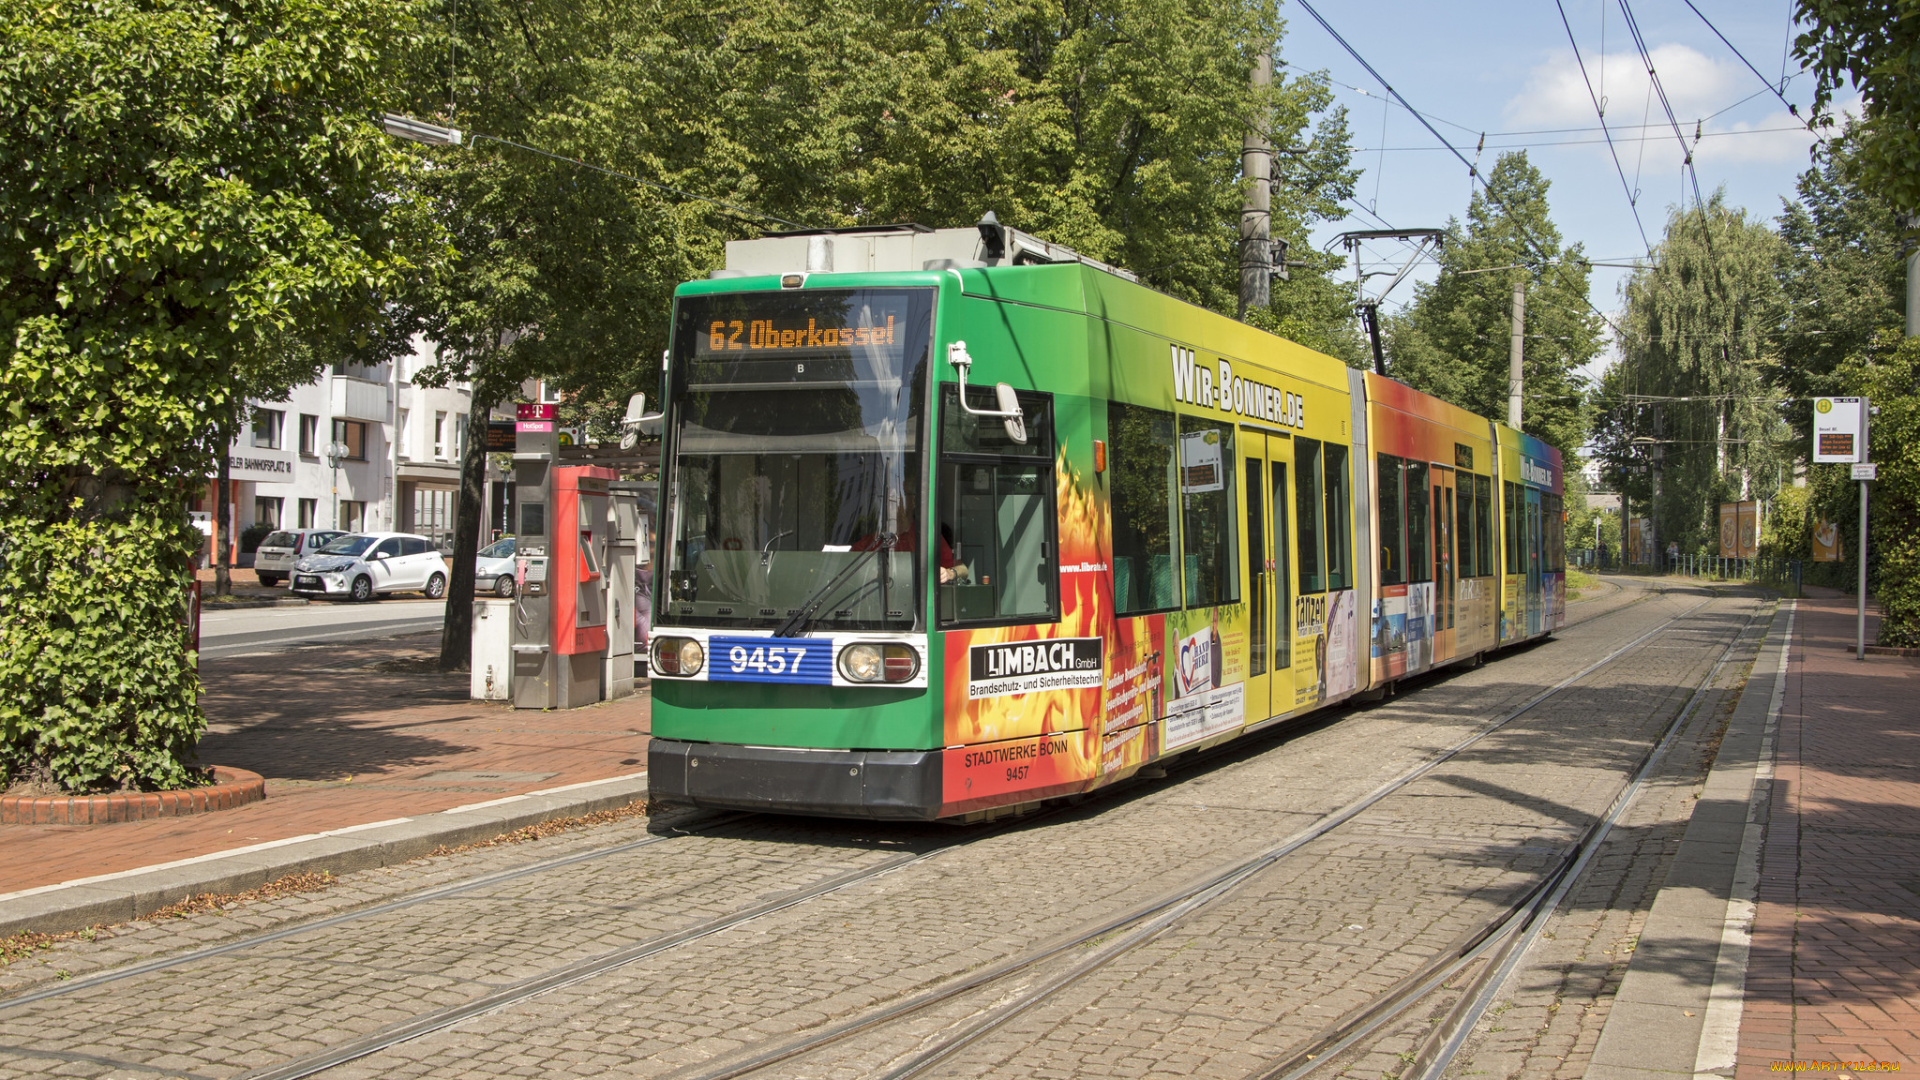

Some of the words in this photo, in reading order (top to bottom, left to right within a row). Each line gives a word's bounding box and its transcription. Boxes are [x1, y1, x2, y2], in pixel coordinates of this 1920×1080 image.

[710, 320, 743, 351] 62
[750, 316, 895, 349] Oberkassel
[797, 363, 805, 374] B
[532, 404, 543, 418] T
[228, 456, 243, 469] ELER
[244, 458, 285, 473] BAHNHOFSPLATZ
[286, 461, 291, 473] 18
[1296, 595, 1325, 632] tanzen
[729, 646, 807, 675] 9457
[987, 642, 1075, 678] LIMBACH
[1075, 657, 1097, 670] GmbH
[970, 681, 1022, 697] Brandschutz-
[1024, 678, 1038, 691] und
[1040, 673, 1103, 689] Sicherheitstechnik
[965, 744, 1037, 768] STADTWERKE
[1039, 740, 1068, 757] BONN
[1006, 766, 1029, 782] 9457
